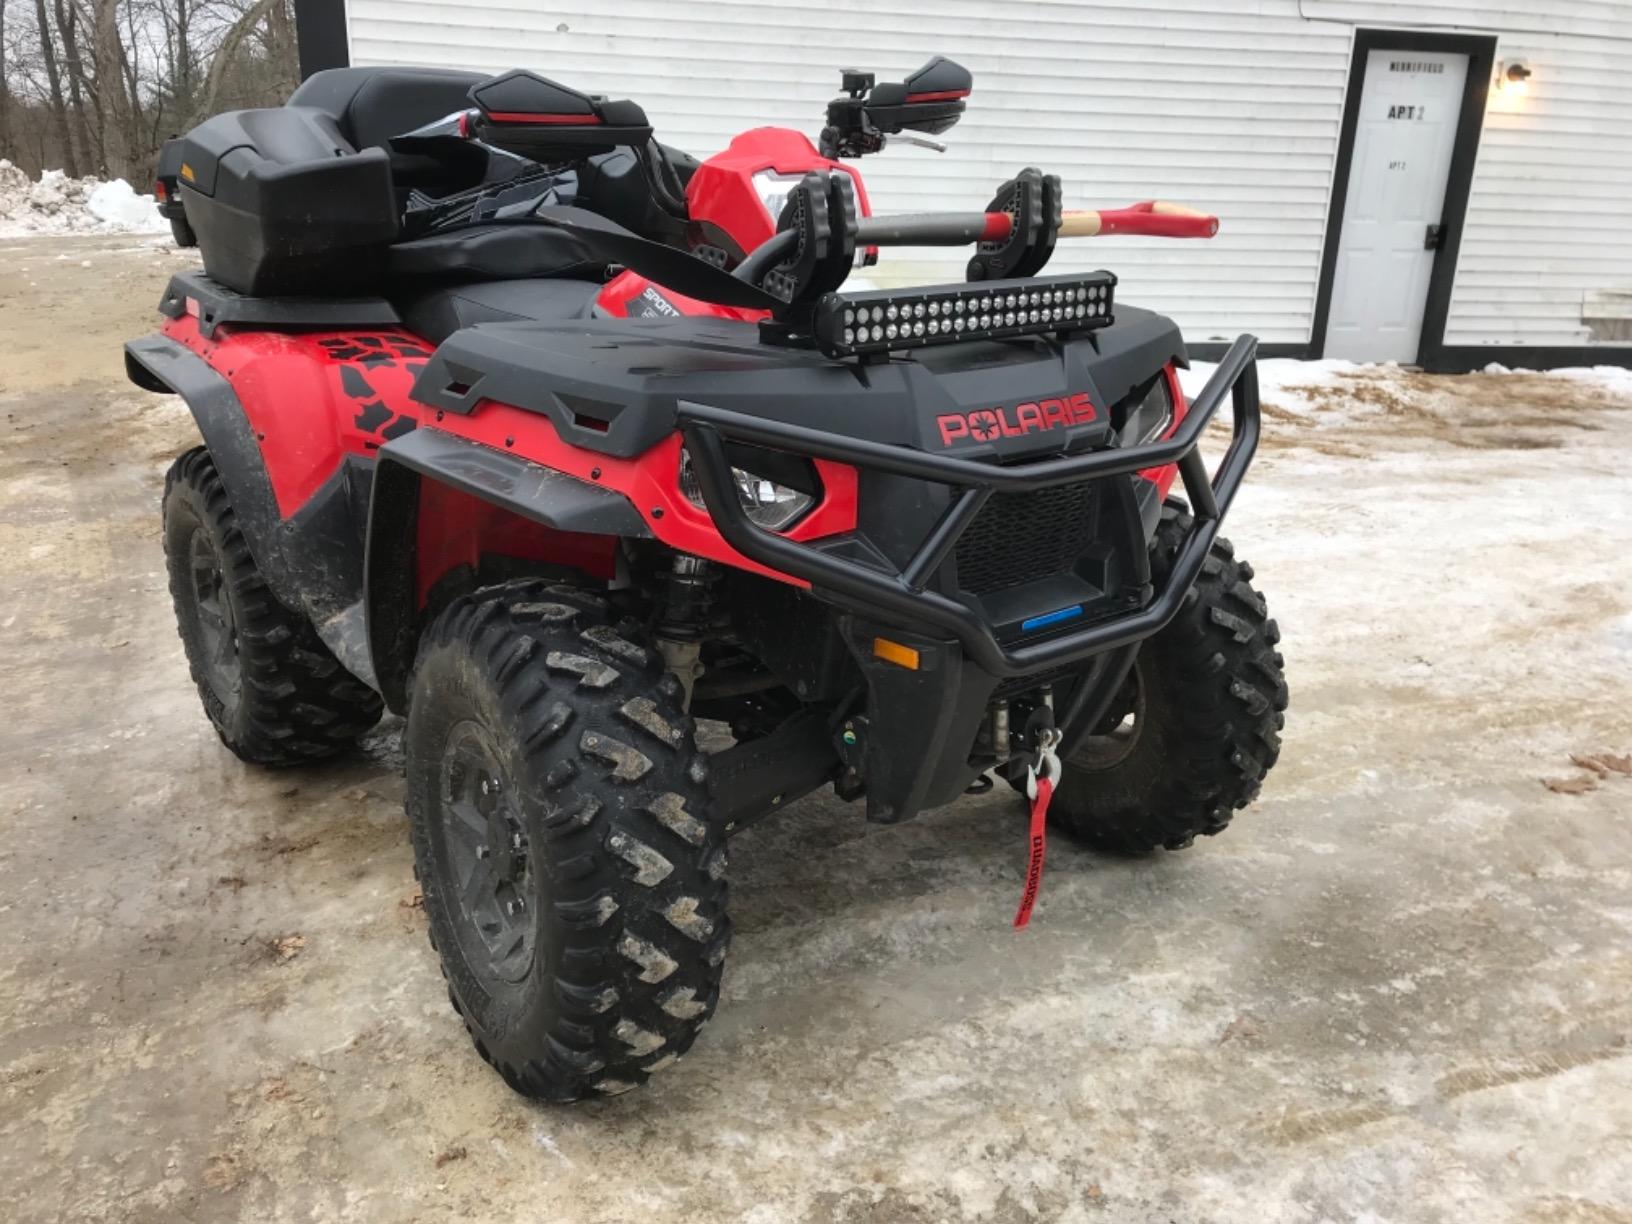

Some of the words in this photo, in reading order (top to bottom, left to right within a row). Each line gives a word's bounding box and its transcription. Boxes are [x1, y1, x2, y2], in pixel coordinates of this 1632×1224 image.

[1387, 105, 1415, 119] APT
[642, 287, 680, 317] SPORT
[936, 392, 1097, 447] POLARIS
